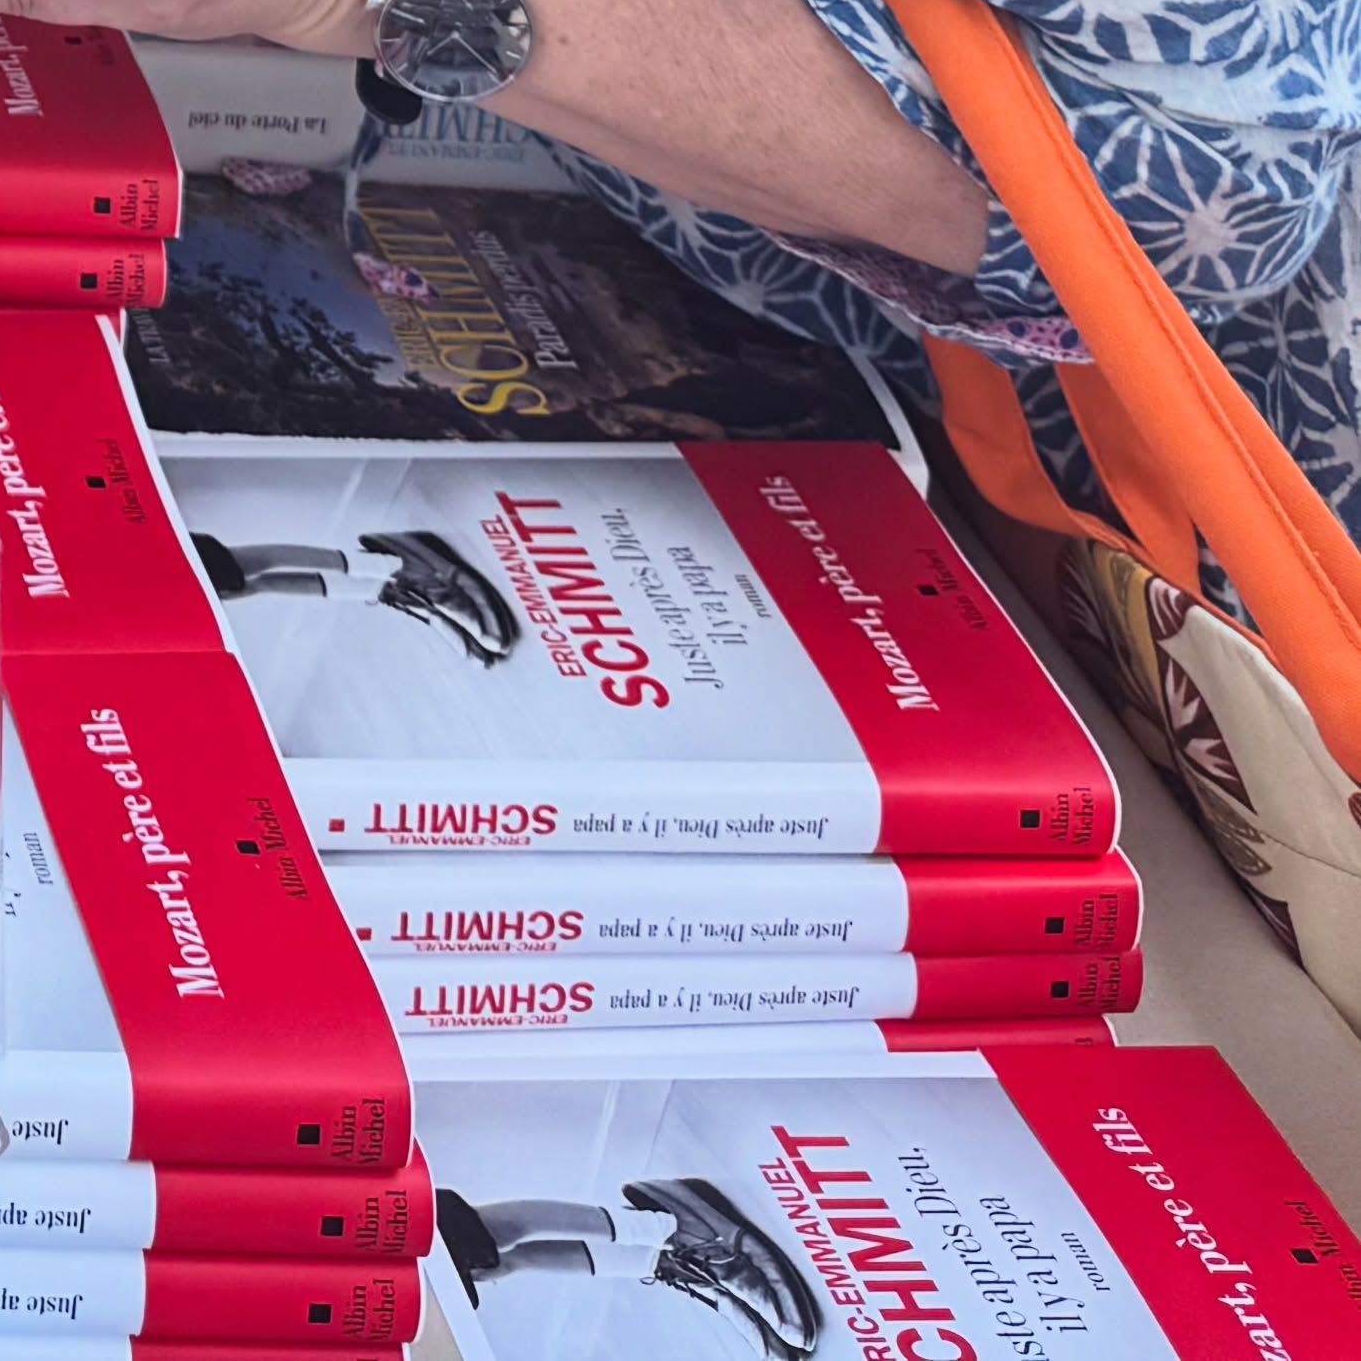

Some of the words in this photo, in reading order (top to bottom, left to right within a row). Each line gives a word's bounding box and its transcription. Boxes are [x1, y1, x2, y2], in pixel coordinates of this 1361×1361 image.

[188, 111, 219, 128] ciel
[225, 113, 248, 129] du
[250, 114, 299, 133] Porte
[305, 118, 327, 135] La
[120, 183, 138, 228] Albin
[141, 178, 159, 231] Michel
[106, 258, 125, 301] Albin
[126, 253, 145, 307] Michel
[759, 476, 808, 514] fils
[6, 500, 70, 598] Mozart,
[601, 508, 651, 563] Dieu,
[787, 518, 825, 542] et
[668, 546, 728, 598] papa
[812, 546, 883, 605] père
[479, 514, 587, 678] ERIC-EMMANUEL
[495, 491, 670, 709] SCHMITT
[630, 566, 691, 628] après
[700, 601, 728, 615] a
[734, 574, 772, 619] roman
[707, 633, 748, 646] il
[712, 620, 748, 632] y
[668, 628, 724, 689] Juste
[849, 607, 940, 712] Mozart,
[80, 708, 132, 756] fils
[102, 760, 142, 790] et
[122, 794, 192, 865] père
[246, 797, 287, 851] Michel
[364, 803, 558, 835] SCHMITT
[573, 814, 615, 833] papa
[622, 820, 632, 833] a
[638, 812, 650, 833] y
[655, 818, 666, 838] il
[673, 817, 719, 839] Dieu,
[726, 814, 775, 837] après
[780, 817, 829, 840] Juste
[1049, 793, 1069, 842] Albin
[1072, 787, 1094, 845] Michel
[23, 833, 54, 885] roman
[279, 857, 311, 901] Albin
[146, 870, 225, 999] Mozart,
[391, 910, 584, 941] SCHMITT
[599, 918, 641, 938] papa
[648, 924, 658, 938] a
[664, 917, 675, 938] y
[681, 923, 692, 943] il
[699, 922, 743, 943] Dieu,
[750, 918, 799, 942] après
[805, 920, 853, 942] Juste
[1074, 900, 1094, 947] Albin
[405, 981, 595, 1016] SCHMITT
[1079, 963, 1098, 1009] Albin
[1099, 956, 1121, 1011] Michel
[332, 1105, 357, 1160] Albin
[358, 1098, 385, 1166] Michel
[1092, 1107, 1153, 1155] fils
[897, 1146, 963, 1219] Dieu,
[1128, 1162, 1175, 1191] et
[35, 1207, 91, 1234] Juste
[355, 1196, 379, 1252] Albin
[381, 1190, 407, 1255] Michel
[770, 1125, 978, 1361] CHMITT
[979, 1196, 1059, 1263] papa
[1164, 1198, 1254, 1275] père
[1284, 1200, 1340, 1257] Michel
[758, 1156, 897, 1361] RIC-EMMANUEL
[941, 1223, 1017, 1305] après
[1026, 1269, 1058, 1286] a
[1061, 1231, 1111, 1292] roman
[26, 1293, 83, 1320] Juste
[342, 1284, 367, 1338] Albin
[368, 1278, 395, 1342] Michel
[1036, 1291, 1085, 1309] y
[1039, 1314, 1089, 1334] il
